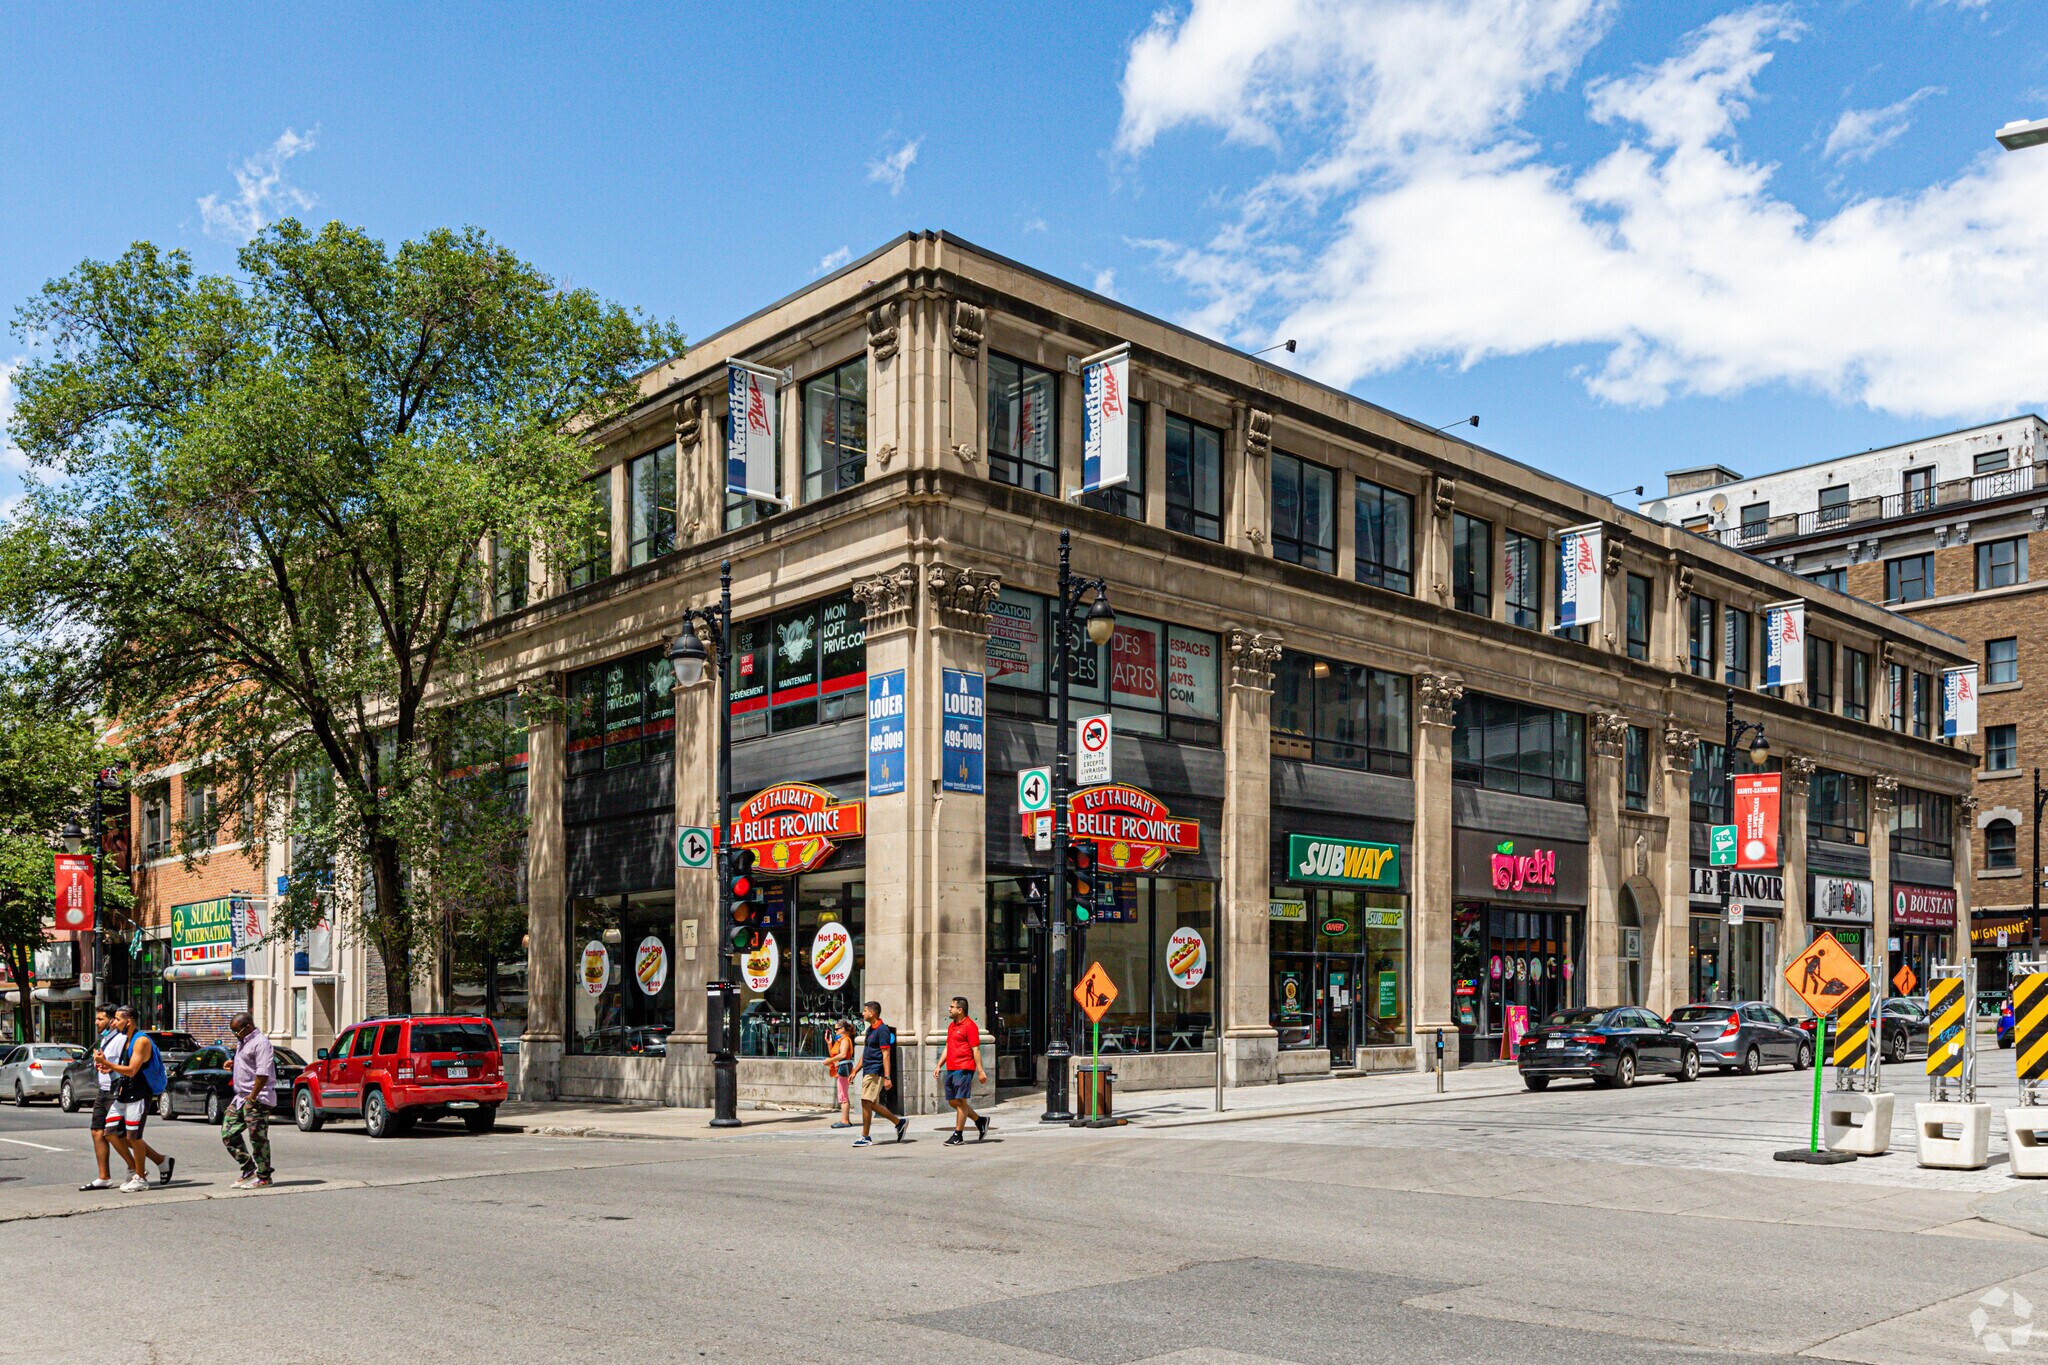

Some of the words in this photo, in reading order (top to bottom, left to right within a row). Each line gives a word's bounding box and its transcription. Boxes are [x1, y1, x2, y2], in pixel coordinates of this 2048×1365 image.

[729, 369, 747, 463] Nautilus
[748, 374, 769, 434] Plus
[1085, 364, 1101, 460] Nautilus
[1102, 363, 1122, 417] Plus
[1562, 536, 1576, 604] Nautilus
[1578, 534, 1596, 574] Plus
[824, 604, 847, 622] MON
[824, 620, 846, 639] LOFT
[1767, 610, 1781, 667] Nautilus
[1782, 609, 1799, 642] Plus
[988, 638, 1020, 649] ORMATION
[1113, 631, 1141, 655] DES
[1170, 638, 1210, 658] ESPACES
[741, 656, 750, 664] DES
[986, 648, 1026, 661] CORPORATIVE
[1170, 654, 1187, 670] DES
[607, 667, 624, 684] MON
[741, 664, 753, 674] ARTS
[1113, 664, 1154, 690] ARTS
[606, 682, 623, 699] LOFT
[779, 674, 812, 688] MAINTENANT
[881, 676, 890, 696] À
[960, 674, 969, 694] À
[1170, 674, 1196, 688] ARTS.
[606, 691, 641, 711] PRIVE.COM
[944, 693, 983, 717] LOUER
[1169, 687, 1195, 704] COM
[1945, 673, 1957, 721] Nautilus
[1958, 673, 1973, 700] Plus
[870, 694, 903, 719] LOUER
[870, 731, 904, 752] 499-0009
[944, 730, 983, 751] 499-0009
[1081, 766, 1107, 774] LIVRAISON
[1737, 786, 1778, 795] SAINTE-CATHERINE
[750, 789, 815, 818] RESTAURANT
[1084, 790, 1157, 817] RESTAURANT
[744, 818, 775, 842] BELLE
[780, 810, 840, 837] PROVINCE
[1077, 812, 1116, 837] BELLE
[1122, 817, 1181, 843] PROVINCE
[1715, 834, 1732, 843] CLSC
[1299, 842, 1394, 880] SUBWAY
[1690, 868, 1713, 896] LE
[190, 899, 231, 925] SURPLUS
[1910, 895, 1955, 914] BOUSTAN
[246, 902, 264, 938] Plus
[1326, 923, 1345, 932] OUVERT
[1367, 911, 1402, 926] SUBWAY
[818, 934, 830, 942] Hot
[833, 933, 847, 943] Dog
[1172, 936, 1185, 944] Hot
[1187, 937, 1200, 947] Dog
[640, 946, 650, 954] Hot
[651, 945, 662, 956] Dog
[1457, 979, 1477, 987] open
